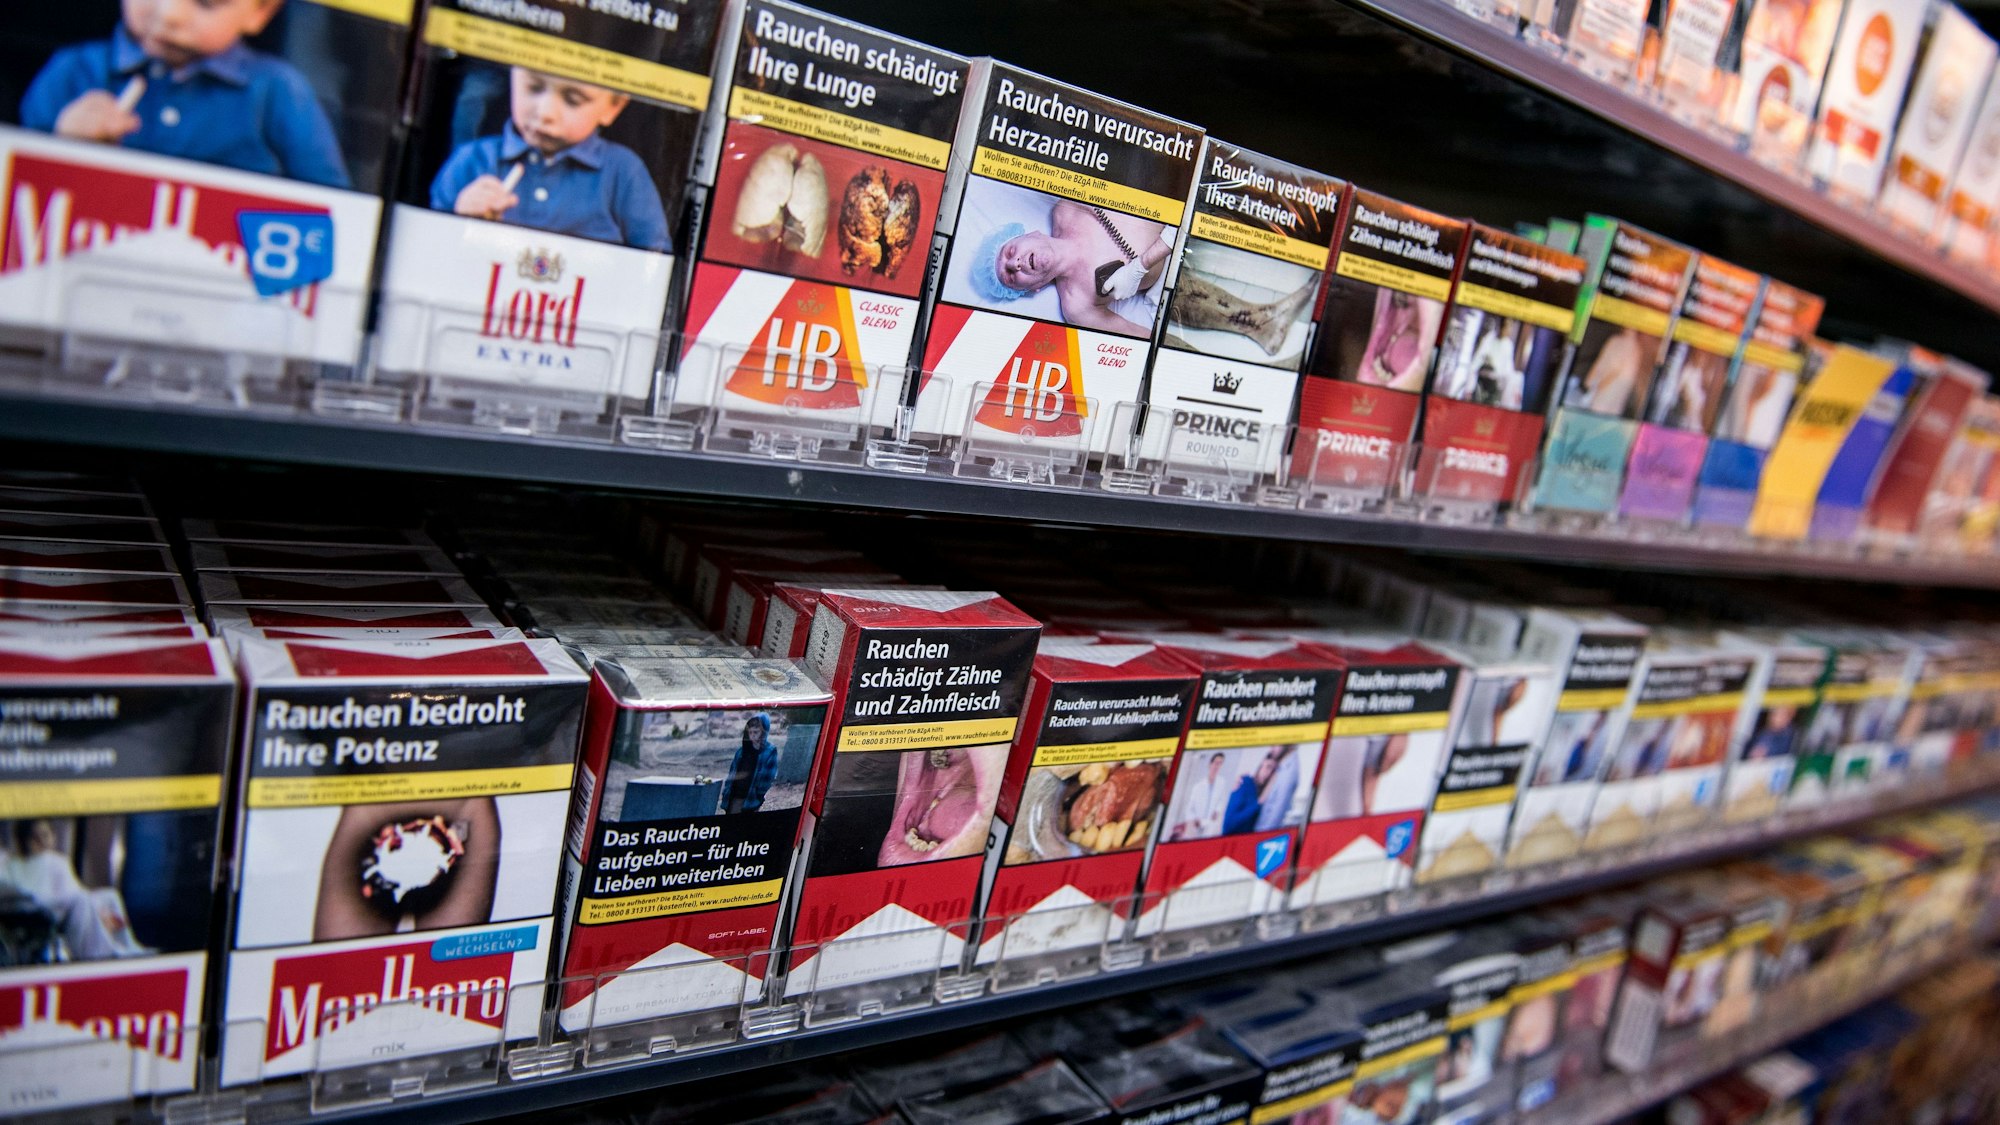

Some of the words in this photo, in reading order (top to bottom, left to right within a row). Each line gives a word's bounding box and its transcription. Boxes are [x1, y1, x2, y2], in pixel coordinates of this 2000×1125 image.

[653, 8, 679, 31] zu
[755, 9, 860, 65] Rauchen
[864, 48, 959, 96] schädigt
[747, 46, 799, 85] Ihre
[803, 62, 877, 108] Lunge
[773, 100, 785, 110] Sie
[829, 115, 842, 125] Die
[996, 79, 1088, 129] Rauchen
[1094, 113, 1194, 161] verursacht
[862, 140, 940, 165] www.rauchfrei-info.de
[988, 115, 1109, 171] Herzanfälle
[984, 150, 1009, 164] Wollen
[1010, 158, 1022, 168] Sie
[1023, 162, 1059, 177] aufhören?
[1060, 171, 1072, 180] Die
[1073, 174, 1091, 187] BZgA
[1092, 179, 1109, 191] hilft:
[981, 164, 995, 175] Tel.:
[996, 168, 1045, 188] 08008313131
[1046, 181, 1087, 200] (kostenfrei),
[1089, 194, 1161, 218] www.rauchfrei-info.de
[1211, 156, 1275, 193] Rauchen
[1277, 180, 1337, 214] verstopft
[1204, 184, 1237, 207] Ihre
[1238, 194, 1297, 227] Arterien
[1219, 221, 1228, 229] Sie
[1354, 205, 1398, 233] Rauchen
[1398, 218, 1440, 246] schädigt
[1349, 225, 1382, 250] Zähne
[1382, 236, 1403, 255] und
[1403, 238, 1455, 271] Zahnfleisch
[478, 261, 586, 349] Lord
[859, 301, 904, 317] CLASSIC
[861, 315, 898, 330] BLEND
[476, 345, 572, 370] EXTRA
[762, 317, 842, 392] HB
[1097, 343, 1133, 357] CLASSIC
[1098, 356, 1127, 368] BLEND
[1004, 356, 1069, 422] HB
[1174, 410, 1261, 443] PRINCE
[1186, 441, 1240, 459] ROUNDED
[1317, 428, 1392, 459] PRINCE
[866, 638, 949, 660] Rauchen
[859, 666, 942, 692] schädigt
[946, 664, 1002, 687] Zähne
[1203, 677, 1263, 699] Rauchen
[1263, 676, 1317, 698] mindert
[265, 697, 401, 730] Rauchen
[408, 694, 527, 728] bedroht
[854, 695, 896, 716] und
[897, 690, 1001, 715] Zahnfleisch
[1053, 698, 1098, 712] Rauchen
[1099, 695, 1148, 710] verursacht
[1197, 703, 1228, 723] Ihre
[1228, 699, 1315, 723] Fruchtbarkeit
[1049, 714, 1091, 728] Rachen-
[1092, 713, 1112, 726] und
[1113, 709, 1179, 727] Kehlkopfkrebs
[847, 738, 861, 746] Tel.:
[884, 736, 907, 744] 313131
[907, 734, 944, 744] (kostenfrei),
[945, 729, 1009, 741] www.rauchfrei-info.de
[879, 728, 907, 737] aufhören?
[907, 727, 916, 735] Die
[917, 727, 931, 737] BZgA
[931, 726, 944, 734] hilft:
[262, 737, 327, 768] Ihre
[334, 736, 439, 766] Potenz
[603, 829, 639, 848] Das
[644, 823, 721, 845] Rauchen
[598, 848, 688, 872] aufgeben
[707, 845, 730, 862] für
[736, 841, 770, 857] Ihre
[594, 873, 657, 894] Lieben
[661, 863, 765, 886] weiterleben
[590, 902, 614, 910] Wollen
[615, 901, 626, 909] Sie
[627, 897, 659, 908] aufhören?
[660, 895, 671, 903] Die
[672, 893, 689, 903] BZgA
[689, 891, 705, 900] hilft:
[606, 910, 624, 918] 0800
[631, 906, 656, 916] 313131
[657, 901, 698, 913] (kostenfrei),
[699, 892, 773, 907] www.rauchfrei-info.de
[708, 930, 735, 940] SOFT
[737, 927, 767, 937] LABEL
[445, 938, 523, 957] WECHSELN?
[371, 1041, 406, 1056] mix
